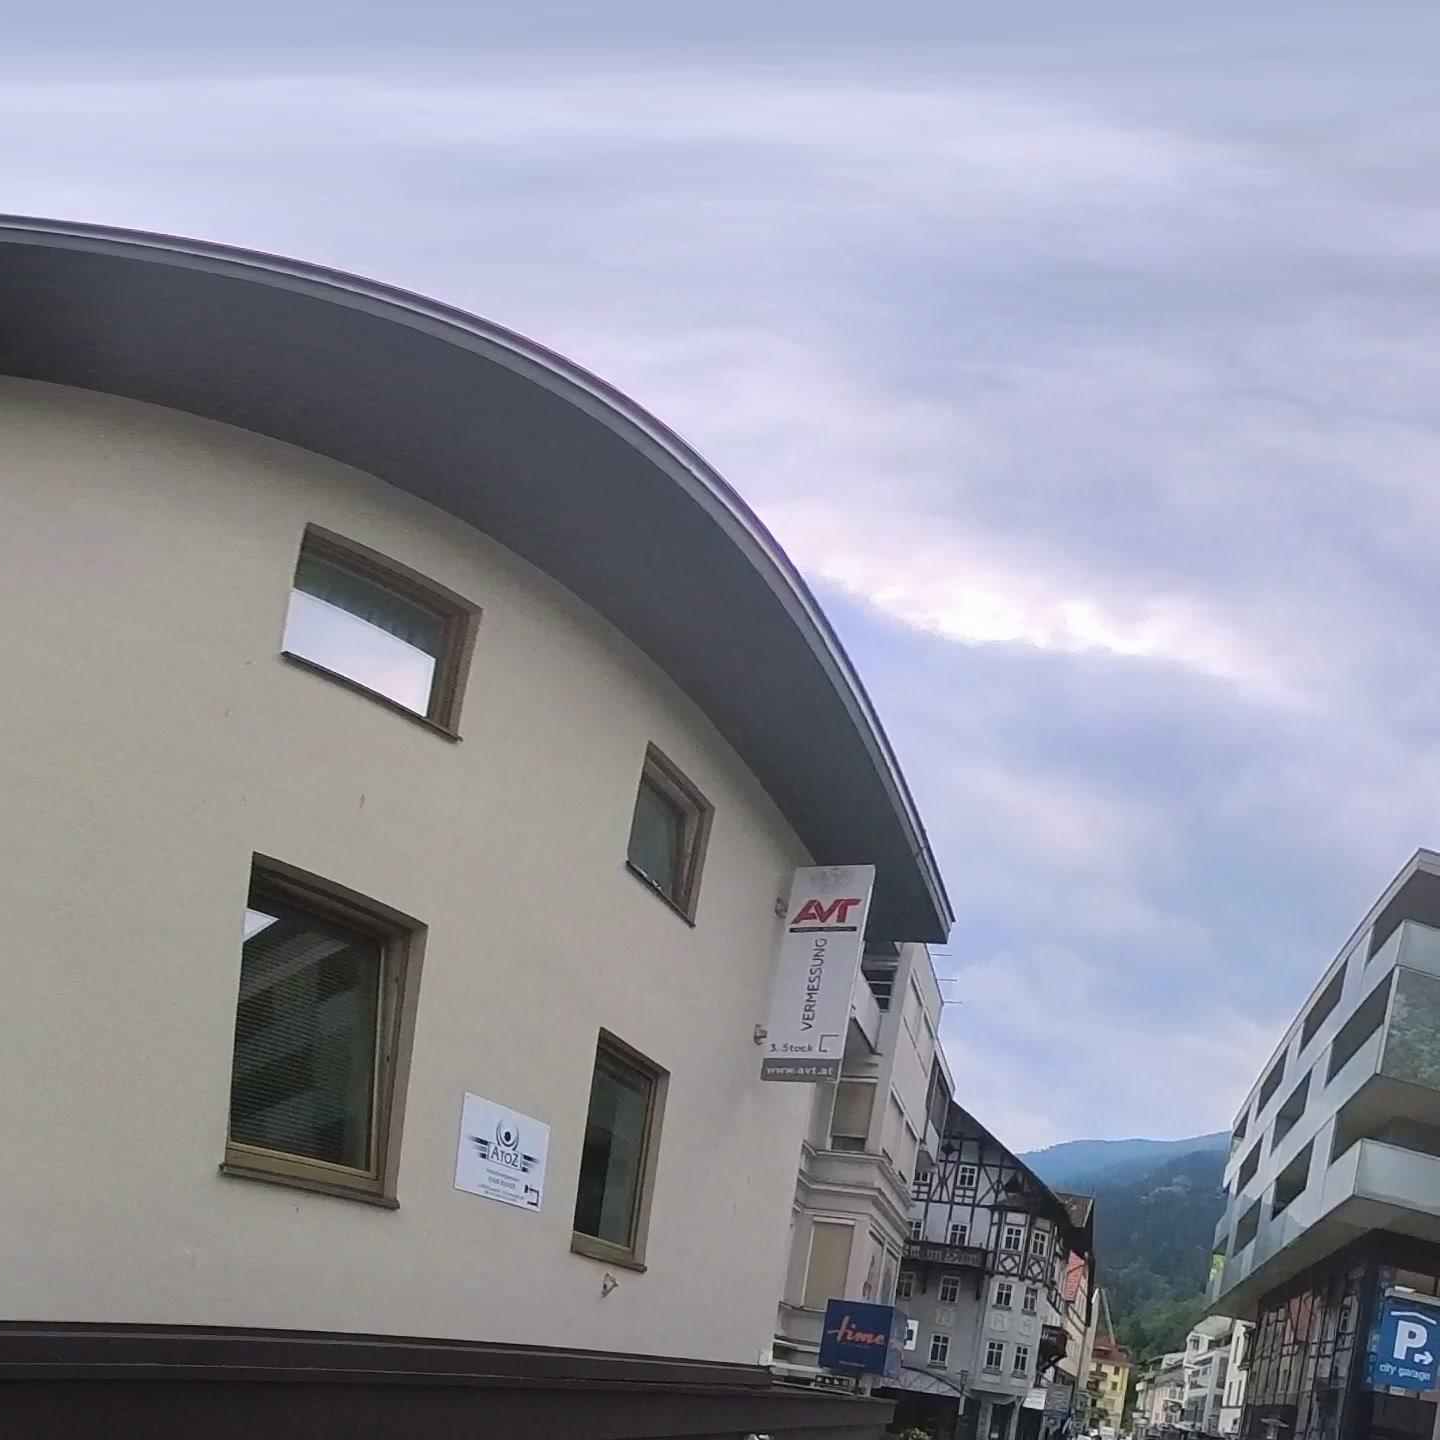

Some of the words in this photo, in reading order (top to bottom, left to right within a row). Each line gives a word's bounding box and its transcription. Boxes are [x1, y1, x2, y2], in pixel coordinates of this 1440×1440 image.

[791, 898, 861, 925] AVT
[800, 937, 828, 1032] VERMESSUNG
[783, 1042, 813, 1053] Stock
[767, 1063, 834, 1077] www.avt.at
[1393, 1319, 1428, 1360] P
